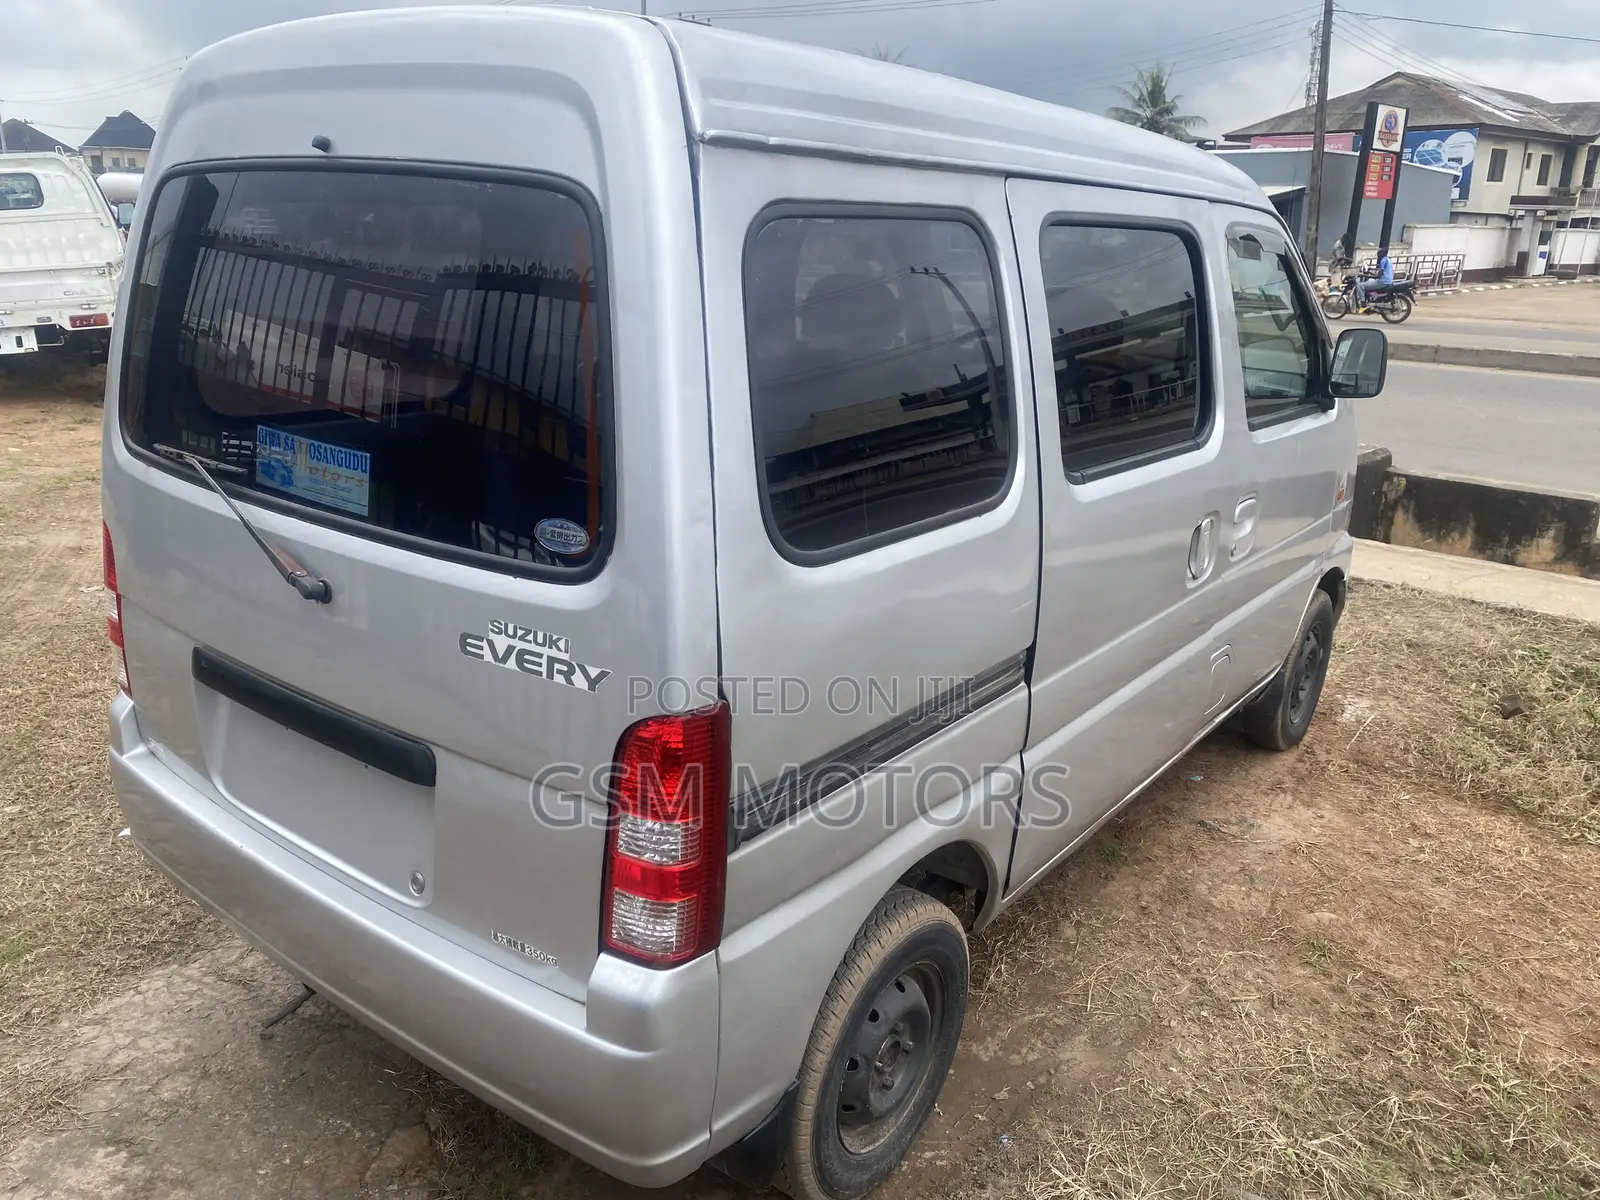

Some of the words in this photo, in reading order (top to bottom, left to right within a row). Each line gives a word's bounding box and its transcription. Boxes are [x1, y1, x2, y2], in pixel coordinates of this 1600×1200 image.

[258, 427, 282, 449] GIWA
[284, 434, 296, 455] SA
[489, 619, 570, 654] SUZUKI
[458, 631, 612, 693] EVERY
